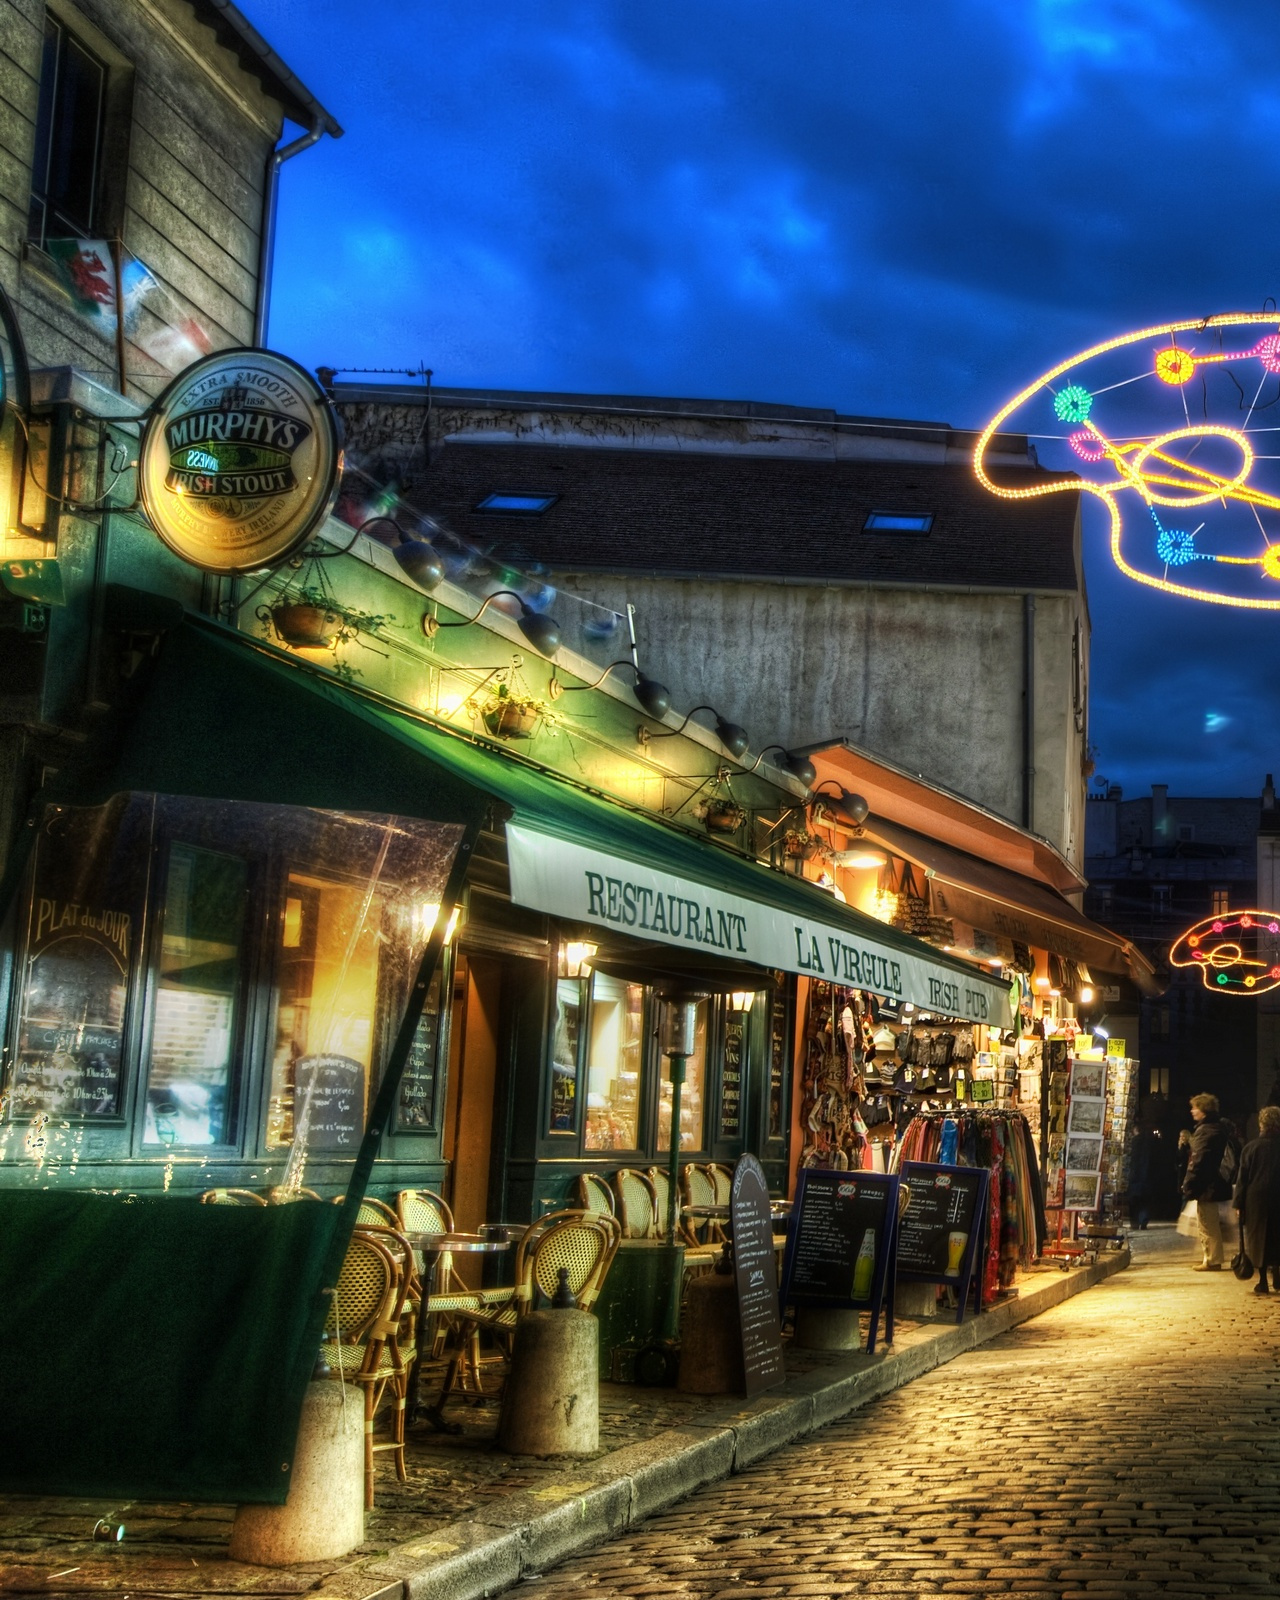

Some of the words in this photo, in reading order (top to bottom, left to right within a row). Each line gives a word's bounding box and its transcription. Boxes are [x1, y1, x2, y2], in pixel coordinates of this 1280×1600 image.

[181, 374, 228, 408] EXTRA
[236, 371, 297, 409] SMOOTH
[246, 398, 265, 406] 1856
[170, 412, 299, 449] MURPHY'S
[172, 472, 217, 494] IRISH
[221, 471, 286, 494] STOUT
[249, 499, 286, 530] IRELAND
[35, 898, 81, 943] PLAT
[81, 906, 96, 929] du
[97, 909, 131, 959] JOUR
[585, 871, 747, 953] RESTAURANT
[795, 927, 825, 974] LA
[828, 937, 903, 996] VIRGULE
[928, 977, 960, 1013] IRISH
[965, 988, 988, 1019] PUB
